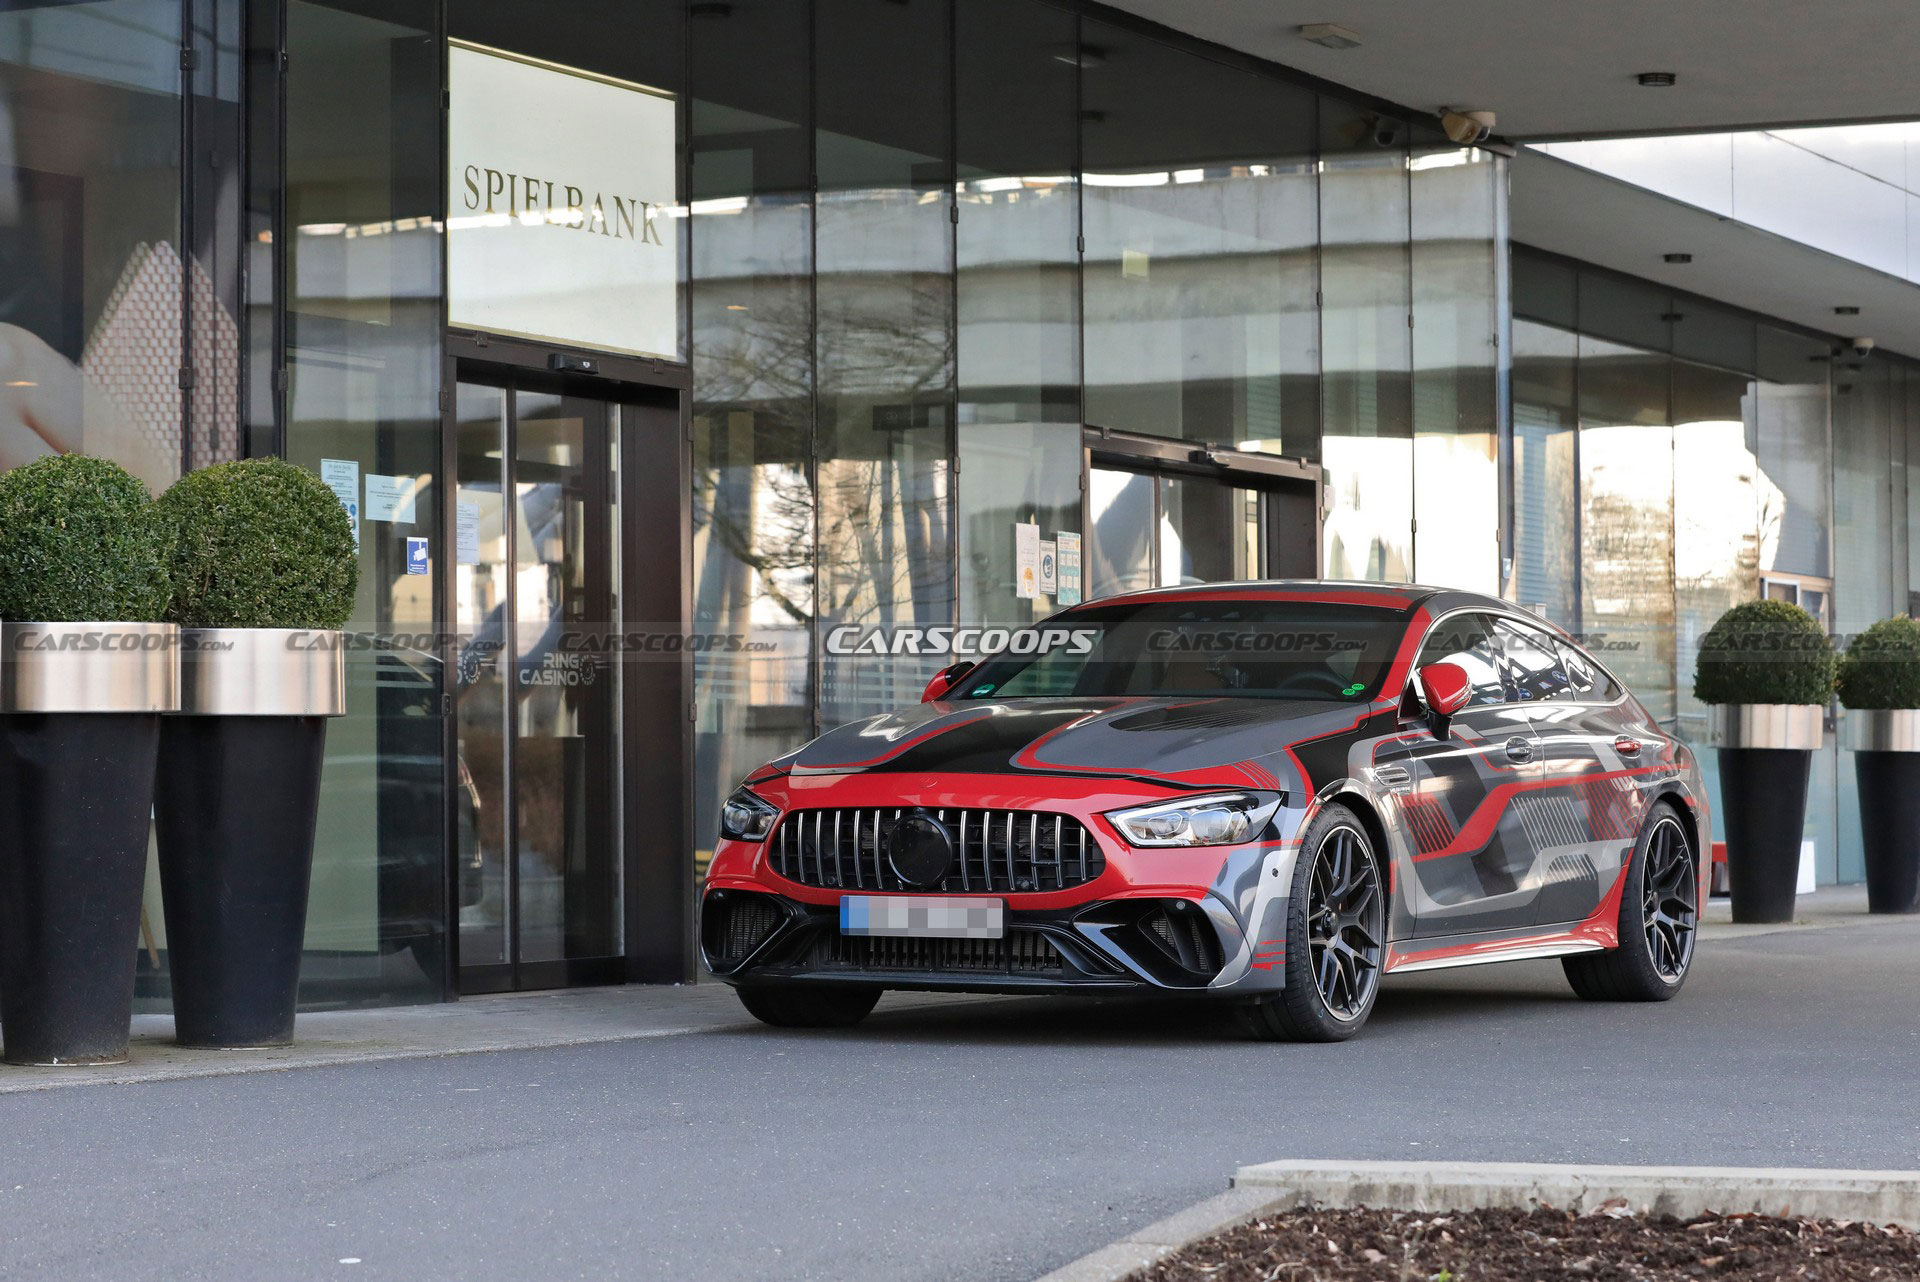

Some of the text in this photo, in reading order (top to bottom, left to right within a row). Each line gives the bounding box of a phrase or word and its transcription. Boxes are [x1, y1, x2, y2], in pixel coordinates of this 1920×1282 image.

[463, 164, 663, 246] SPIELBANK
[543, 652, 580, 669] RING
[519, 669, 580, 686] CASINO
